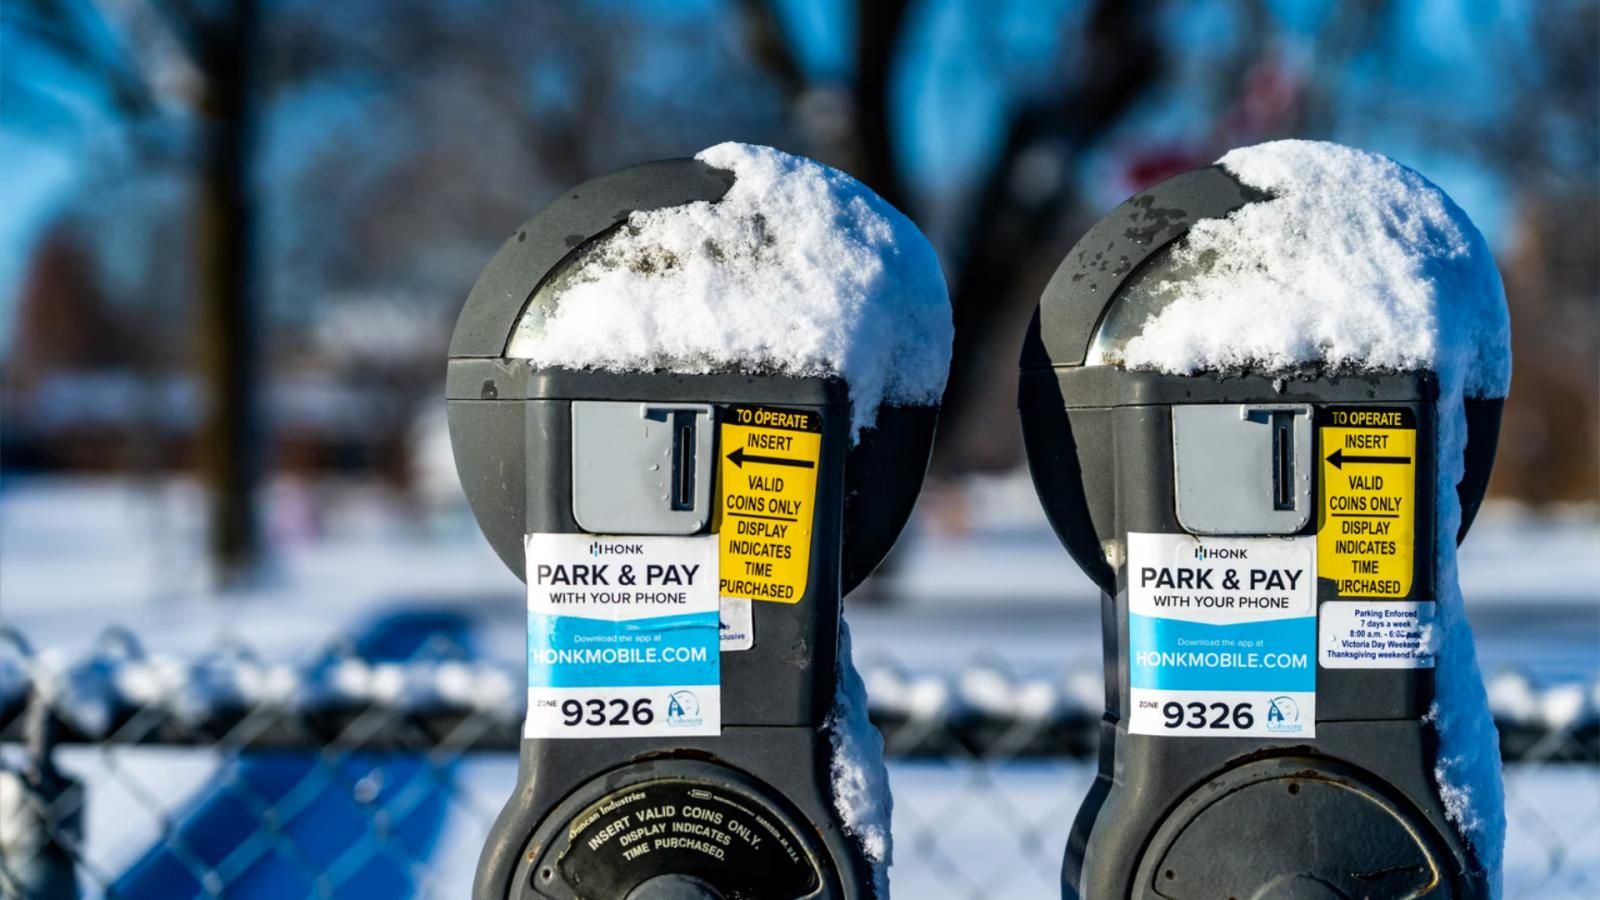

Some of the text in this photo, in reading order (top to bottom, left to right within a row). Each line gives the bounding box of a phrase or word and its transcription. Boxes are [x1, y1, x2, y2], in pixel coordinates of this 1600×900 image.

[736, 408, 808, 429] TO OPERATE
[1332, 411, 1402, 426] TO OPERATE
[747, 433, 793, 451] INSERT
[1345, 434, 1389, 449] INSERT
[748, 475, 784, 493] VALID
[1348, 475, 1384, 491] VALID
[726, 494, 802, 515] COINS ONLY
[1329, 496, 1402, 512] COINS ONLY
[737, 520, 788, 538] DISPLAY
[1342, 520, 1391, 535] DISPLAY
[604, 544, 644, 555] HONK
[729, 540, 792, 559] INDICATES
[1209, 548, 1248, 559] HONK
[1335, 540, 1396, 555] INDICATES
[537, 564, 700, 586] PARK & PAY
[745, 561, 773, 577] TIME
[1352, 560, 1379, 574] TIME
[1141, 567, 1304, 590] PARK & PAY
[1336, 579, 1401, 594] URCHASED
[719, 579, 794, 599] PURCHASED
[549, 592, 687, 604] WITH YOUR PHONE
[1153, 595, 1289, 609] WITH YOUR PHONE
[1354, 609, 1417, 619] Parking Enforced
[1360, 620, 1366, 628] 7
[1367, 619, 1385, 629] days
[1392, 620, 1411, 628] week
[574, 634, 662, 643] Download the app at
[1177, 638, 1264, 648] Download the app at
[1341, 640, 1420, 650] Victoria Day Weekend
[533, 647, 707, 664] HONKMOBILE.COM
[1136, 651, 1307, 669] HONKMOBILE.COM
[1327, 650, 1377, 660] Thanksgiving
[1378, 650, 1410, 659] weekend
[561, 698, 654, 726] 9326
[1139, 701, 1255, 730] ZONE 9326
[600, 791, 647, 815] Industries
[588, 815, 630, 851] INSERT
[635, 806, 676, 822] VALID
[682, 806, 724, 825] COINS
[728, 820, 762, 850] ONLY.
[619, 822, 731, 847] DISPLAY INDICATES
[622, 837, 725, 861] TIME PURCHASED.
